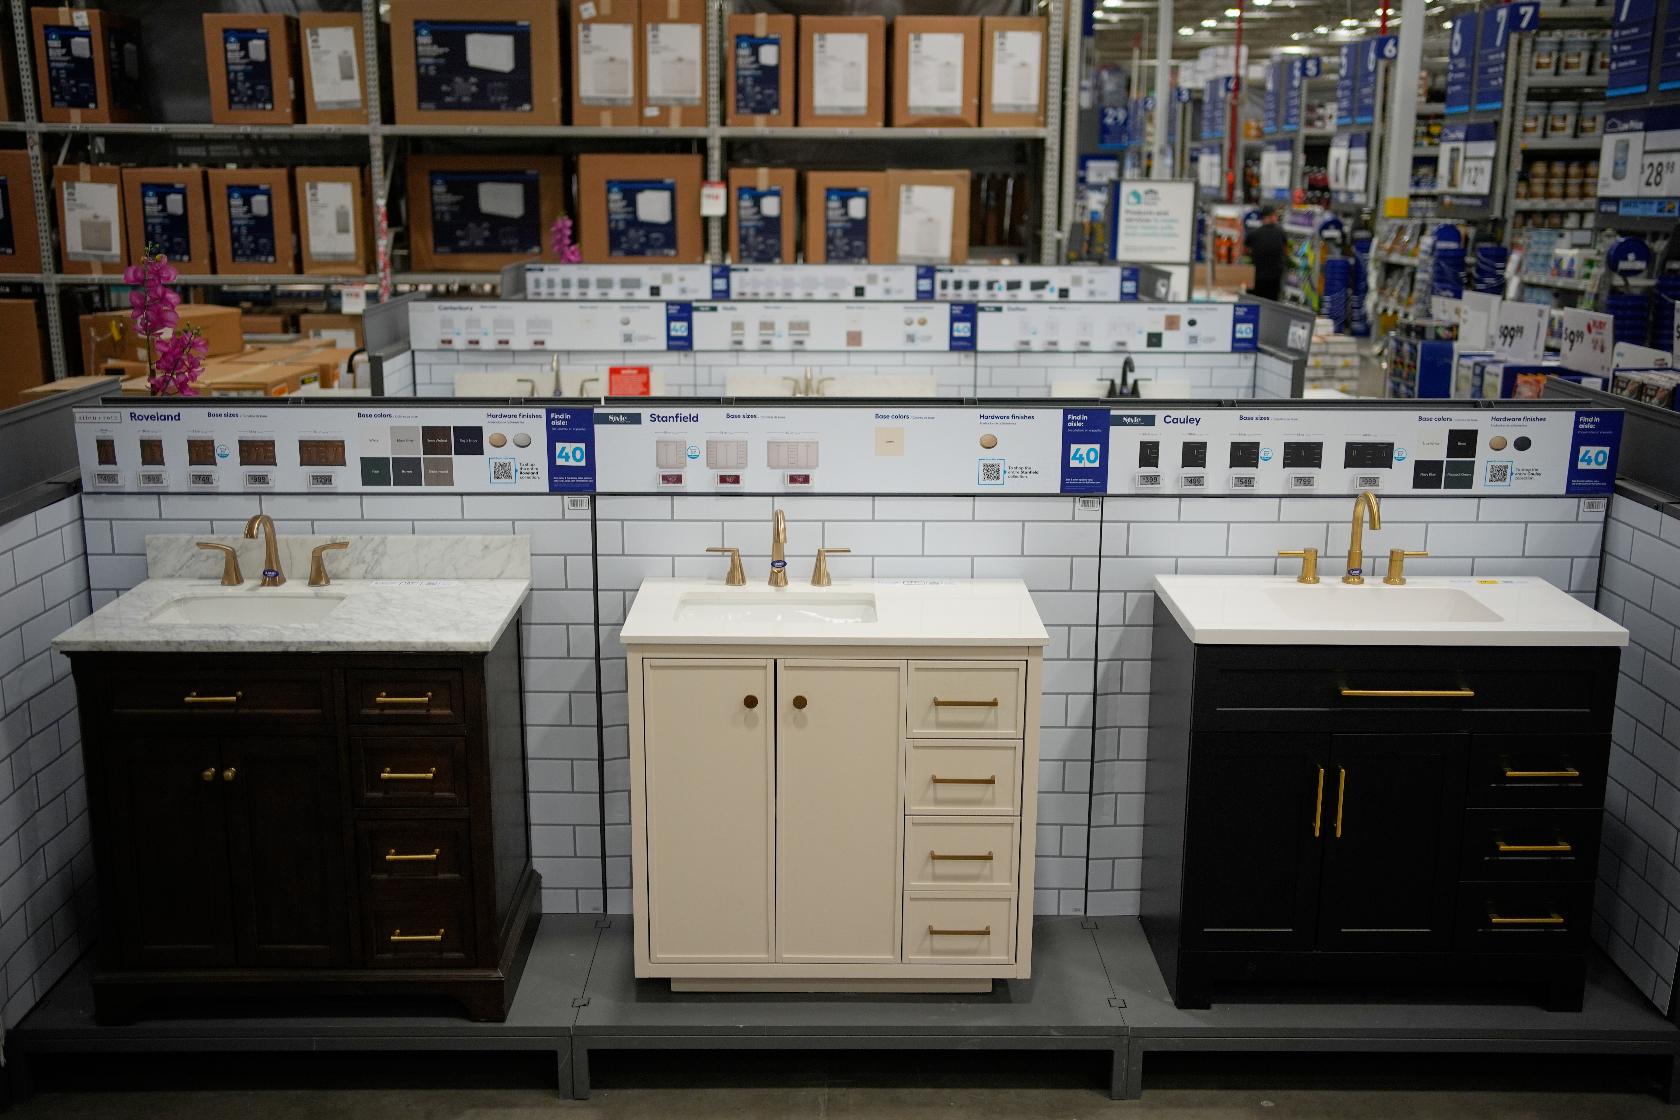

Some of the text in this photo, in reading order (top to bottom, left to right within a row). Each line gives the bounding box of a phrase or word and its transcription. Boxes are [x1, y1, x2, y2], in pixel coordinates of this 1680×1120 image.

[1520, 6, 1534, 28] 7
[1496, 8, 1508, 47] 7
[1452, 18, 1462, 56] 6
[1383, 38, 1396, 58] 6
[1306, 58, 1318, 77] 5
[1104, 106, 1128, 126] 29
[671, 324, 688, 334] 40
[954, 324, 970, 334] 40
[1237, 326, 1253, 334] 40
[129, 412, 181, 421] Roveland
[649, 413, 699, 423] Stanfield
[1122, 416, 1141, 424] Style
[1163, 415, 1201, 426] Cauley
[557, 446, 585, 463] 40
[1071, 448, 1099, 464] 40
[1580, 449, 1607, 466] 40
